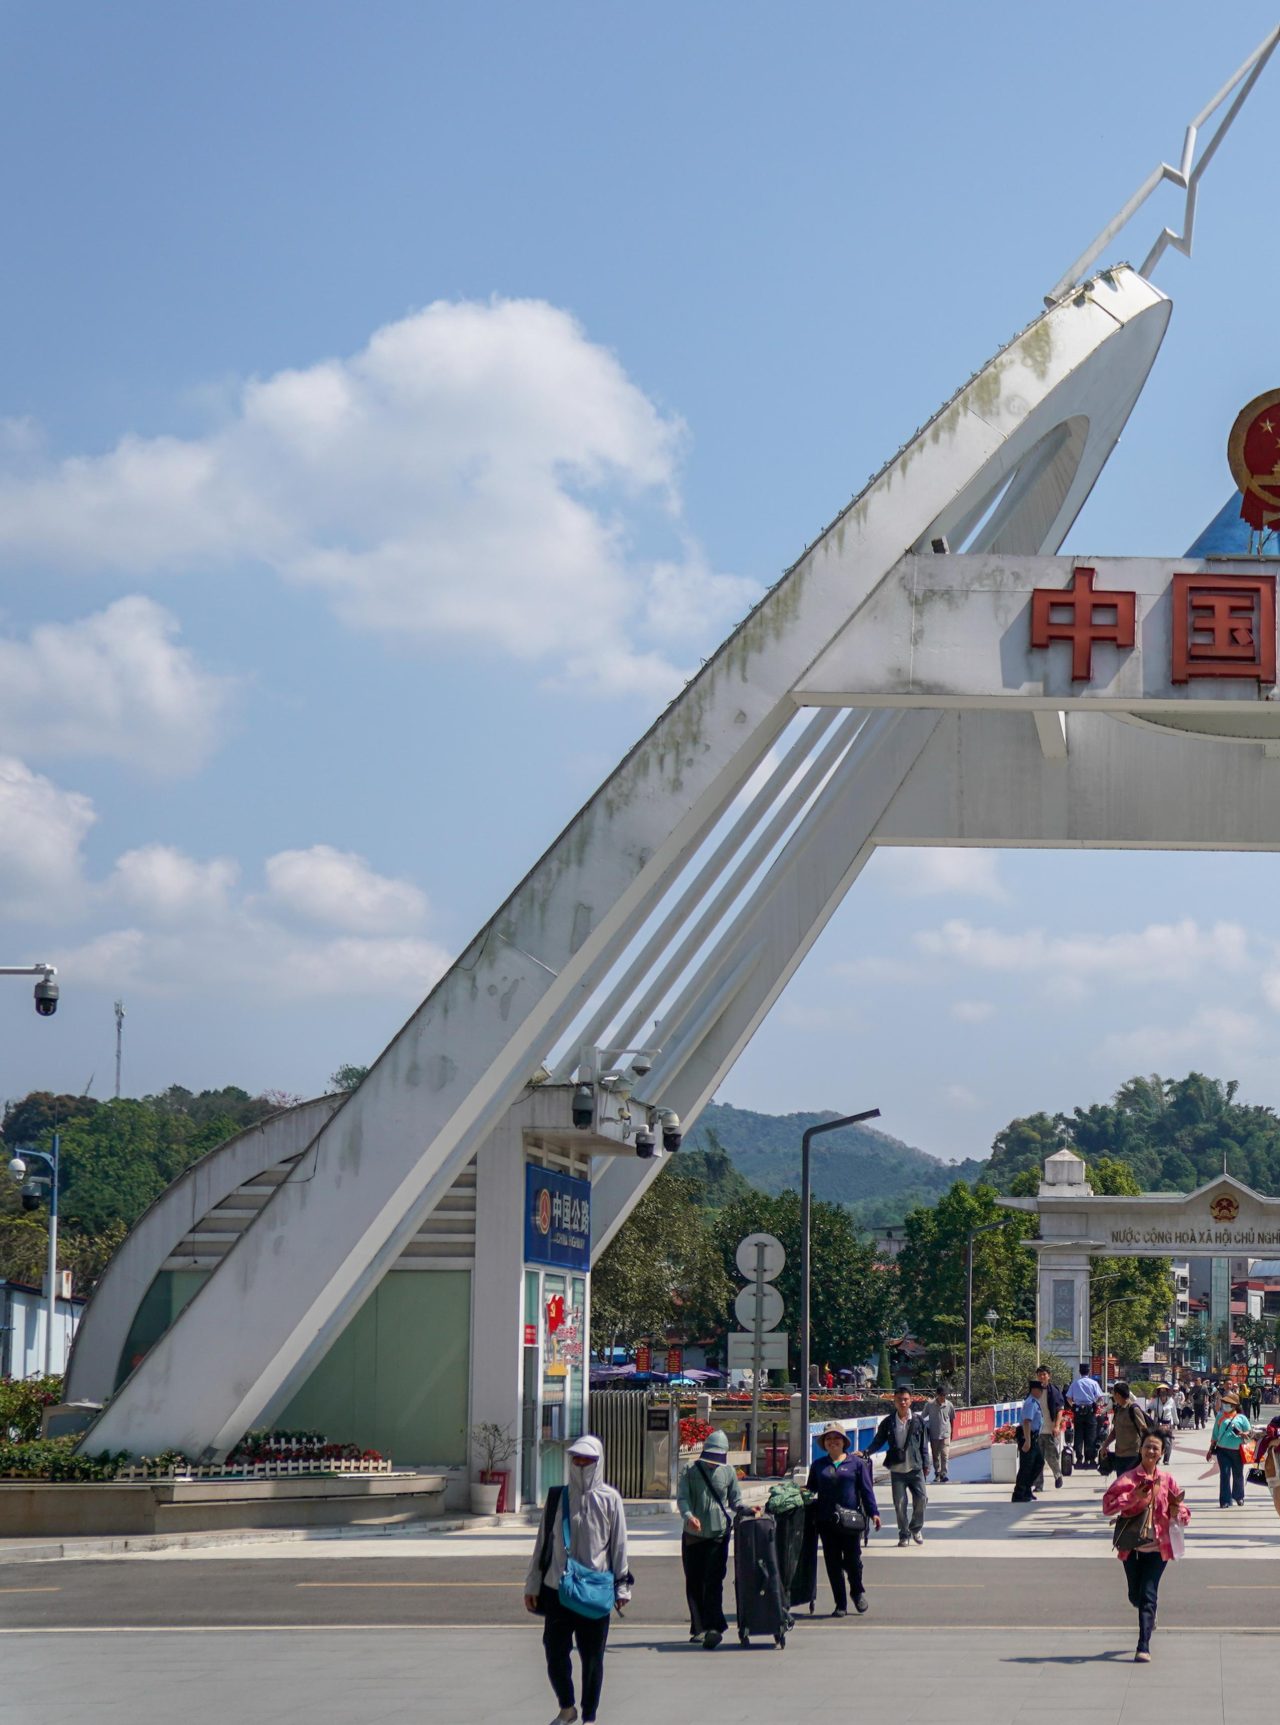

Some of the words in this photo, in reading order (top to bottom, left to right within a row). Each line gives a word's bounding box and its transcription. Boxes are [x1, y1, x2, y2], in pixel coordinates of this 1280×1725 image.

[553, 1191, 589, 1235] 中国公路
[1111, 1227, 1140, 1246] NƯỚC
[1143, 1227, 1172, 1246] CỘNG
[1174, 1228, 1197, 1244] HOÀ
[1198, 1229, 1213, 1244] XÃ
[1215, 1228, 1232, 1247] HỘI
[1234, 1227, 1255, 1245] CHỦ
